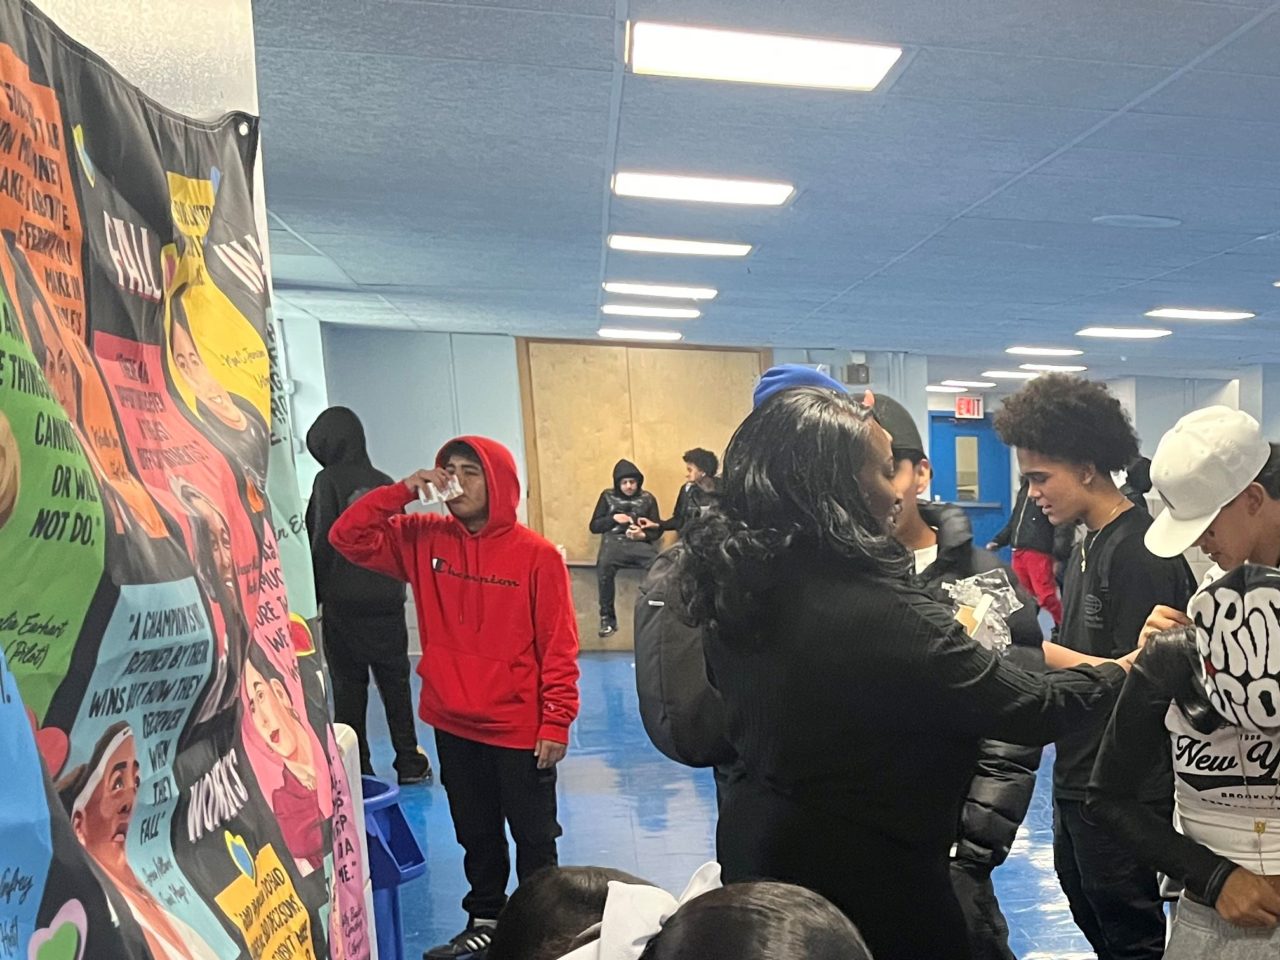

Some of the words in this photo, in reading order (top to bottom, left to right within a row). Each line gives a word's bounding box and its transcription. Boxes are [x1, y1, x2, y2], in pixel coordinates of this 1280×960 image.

[957, 397, 981, 416] EXIT
[29, 508, 70, 541] NOT
[431, 557, 520, 588] Champion
[88, 686, 127, 718] WINS
[1176, 734, 1238, 772] New
